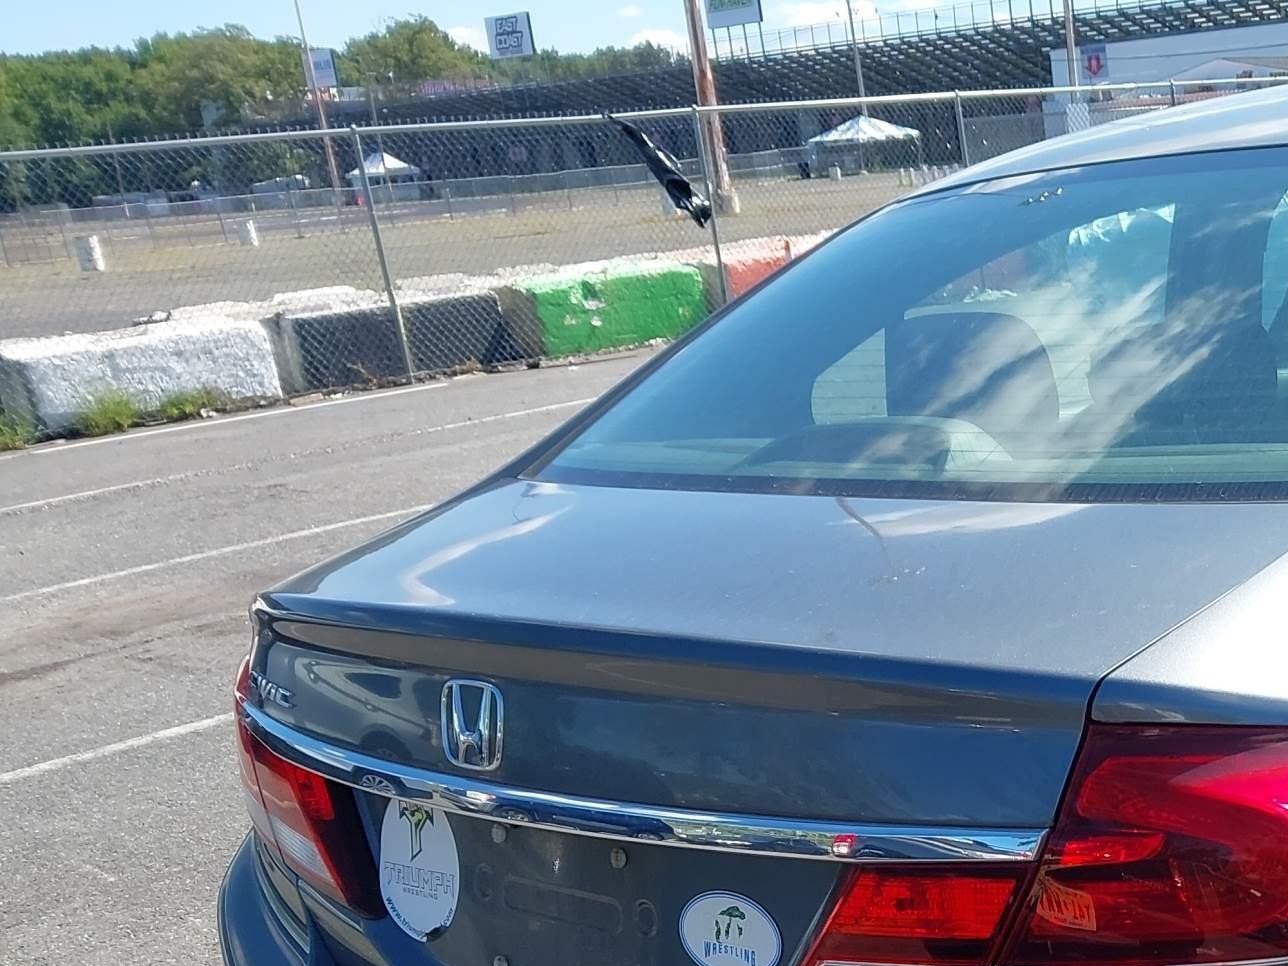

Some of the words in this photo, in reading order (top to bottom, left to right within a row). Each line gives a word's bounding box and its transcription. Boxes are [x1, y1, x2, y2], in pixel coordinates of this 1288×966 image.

[495, 16, 518, 33] EAST
[495, 31, 523, 50] COAST
[384, 861, 454, 897] TRIUMPH
